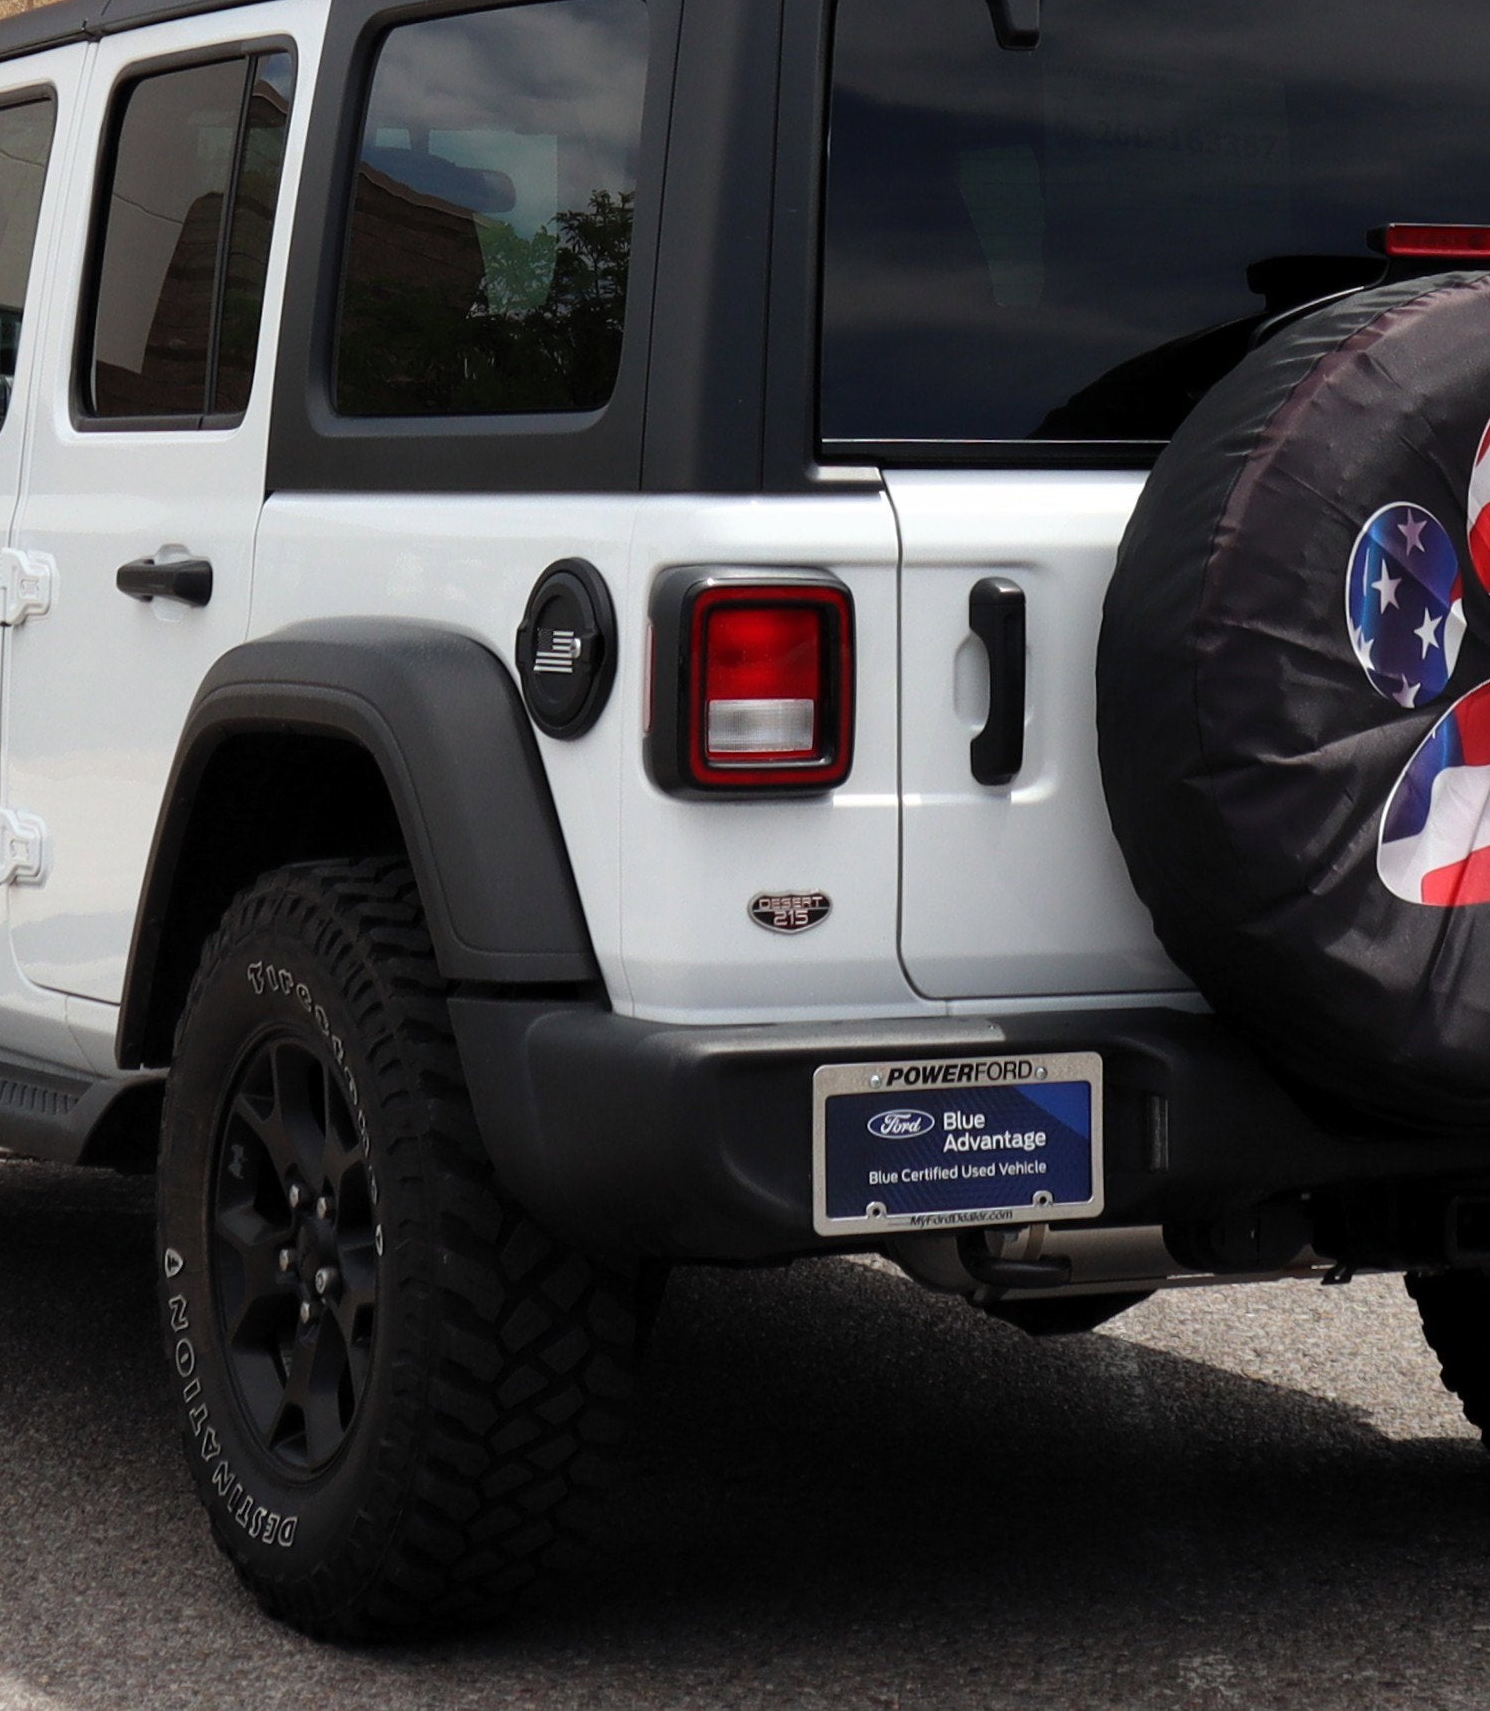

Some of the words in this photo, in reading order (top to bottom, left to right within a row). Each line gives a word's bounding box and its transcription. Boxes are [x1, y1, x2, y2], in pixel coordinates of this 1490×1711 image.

[758, 896, 823, 910] DESERT
[773, 909, 809, 926] 215
[886, 1060, 1033, 1087] POWERFORD
[880, 1112, 923, 1135] Ford
[943, 1110, 986, 1131] Blue
[943, 1130, 1047, 1154] Advantage
[869, 1170, 899, 1185] Blue
[901, 1166, 959, 1183] Certified
[961, 1163, 996, 1179] Used
[999, 1160, 1047, 1177] Vehicle
[168, 1293, 299, 1548] DESTINATION
